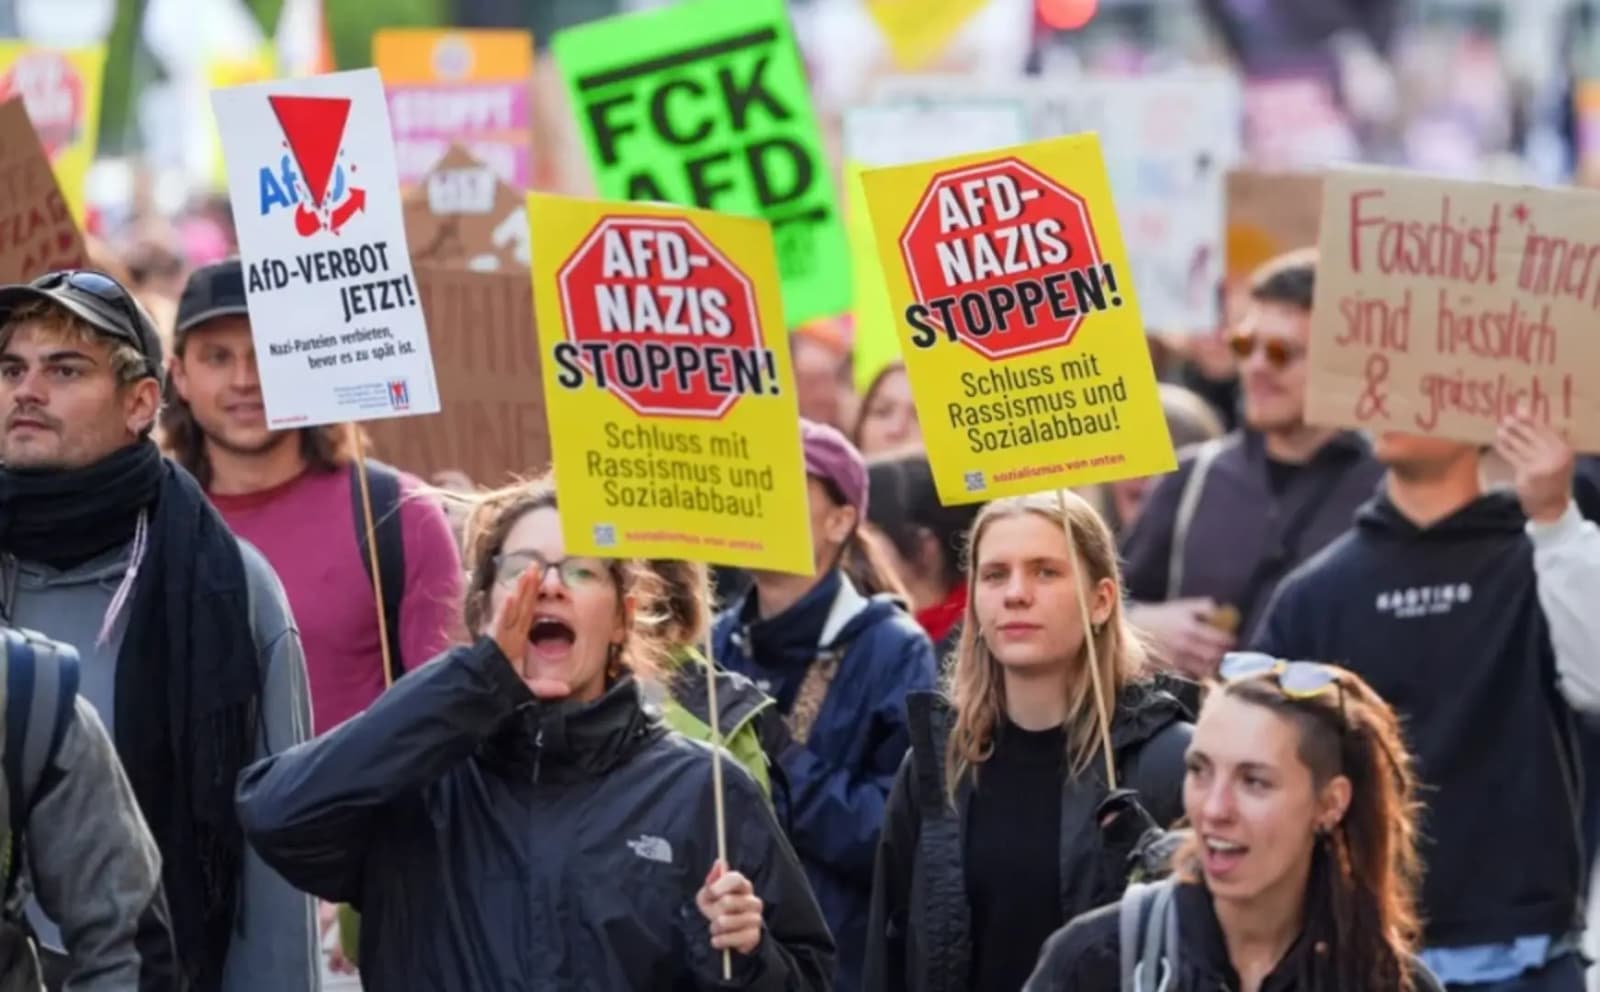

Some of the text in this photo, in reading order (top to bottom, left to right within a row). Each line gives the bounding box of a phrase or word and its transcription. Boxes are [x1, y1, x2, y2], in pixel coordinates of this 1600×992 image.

[587, 56, 793, 165] FCK
[938, 174, 1041, 234] AFD-
[249, 241, 389, 293] AfD-VERBOT
[602, 229, 709, 279] AFD-
[936, 218, 1070, 287] NAZIS
[340, 274, 416, 323] JETZT!
[594, 284, 733, 337] NAZIS
[905, 263, 1122, 348] STOPPEN!
[1335, 287, 1412, 352] sind
[269, 326, 394, 356] Nazi-Parteien verbieten,
[308, 340, 416, 370] bevor es zu spät ist.
[554, 343, 780, 396] STOPPEN!
[961, 353, 1101, 398] Schluss mit
[1355, 353, 1391, 420] &
[948, 376, 1127, 428] Rassismus und
[603, 422, 748, 460] Schluss mit
[967, 407, 1120, 453] Sozialabbau!
[586, 450, 774, 491] Rassismus und
[993, 454, 1125, 483] sozialismus von unten
[603, 479, 763, 518] Sozialabbau!
